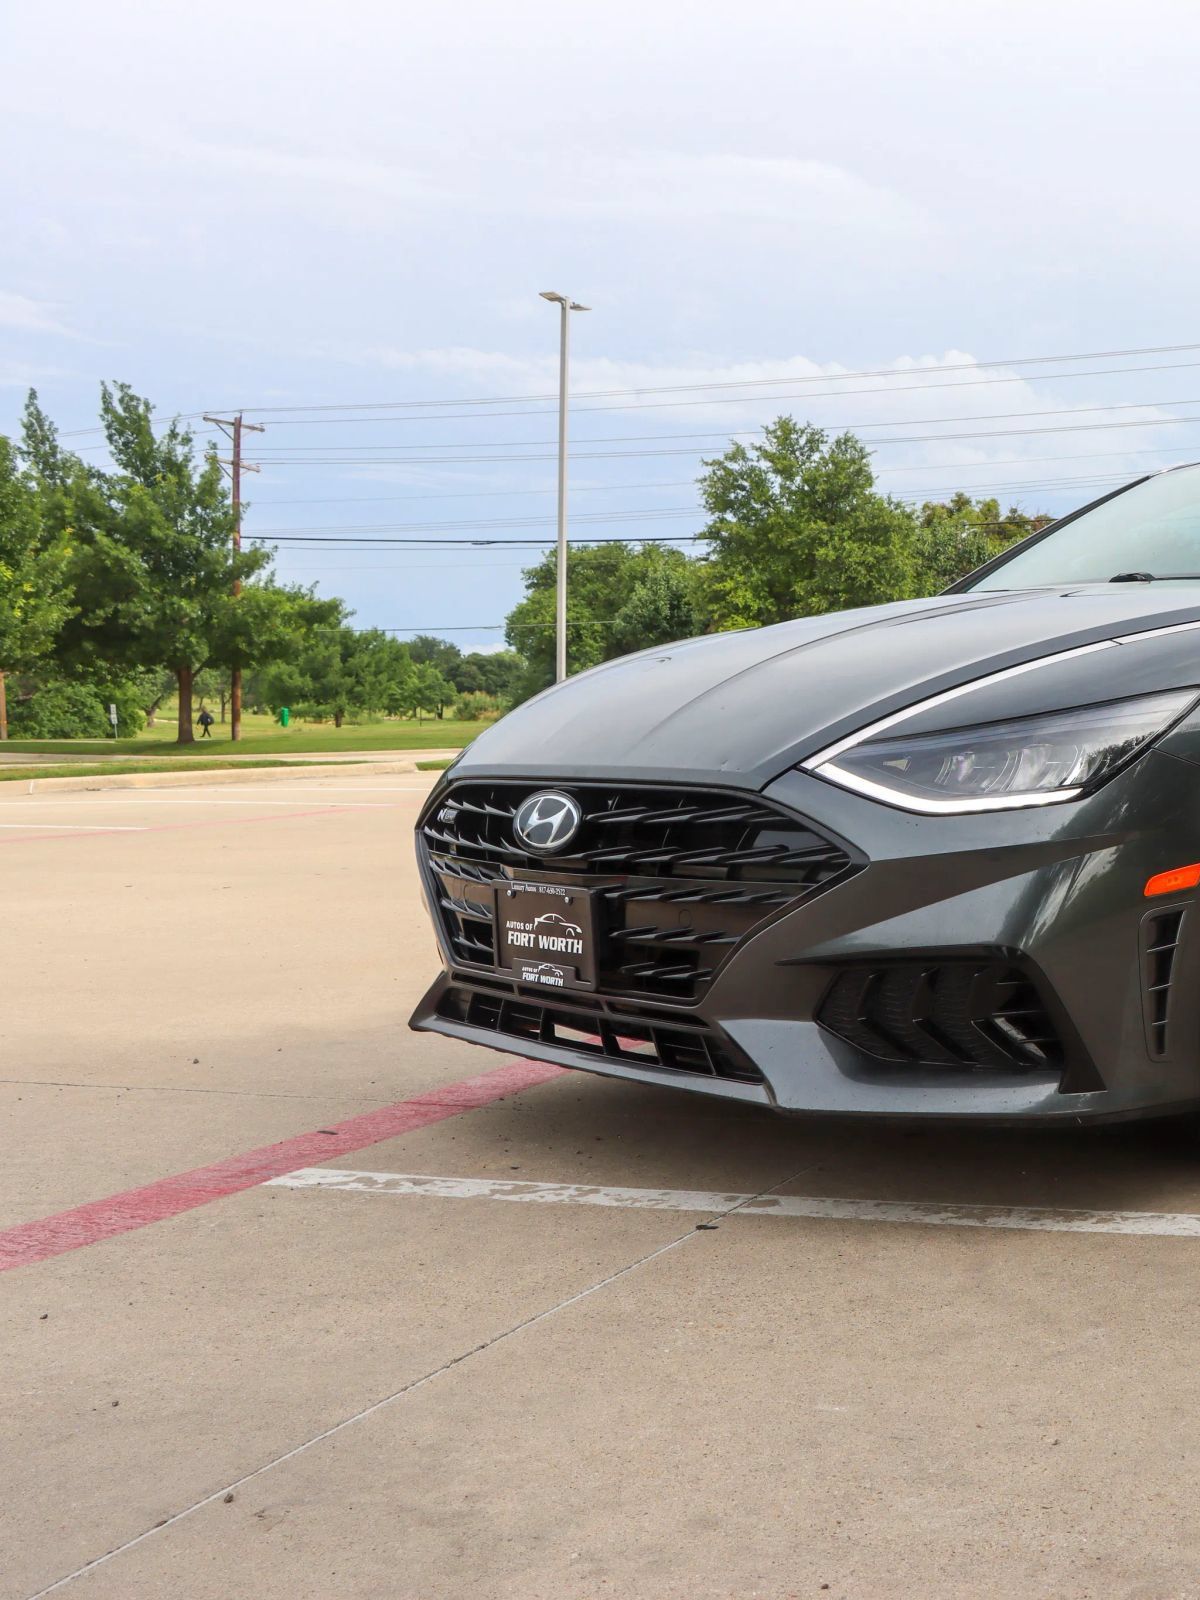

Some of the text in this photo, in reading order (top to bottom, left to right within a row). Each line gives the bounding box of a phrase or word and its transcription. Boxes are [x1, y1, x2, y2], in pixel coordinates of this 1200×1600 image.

[506, 921, 524, 930] AUTOS
[508, 931, 583, 954] FORT WORTH
[522, 972, 564, 987] FORT WORTH
